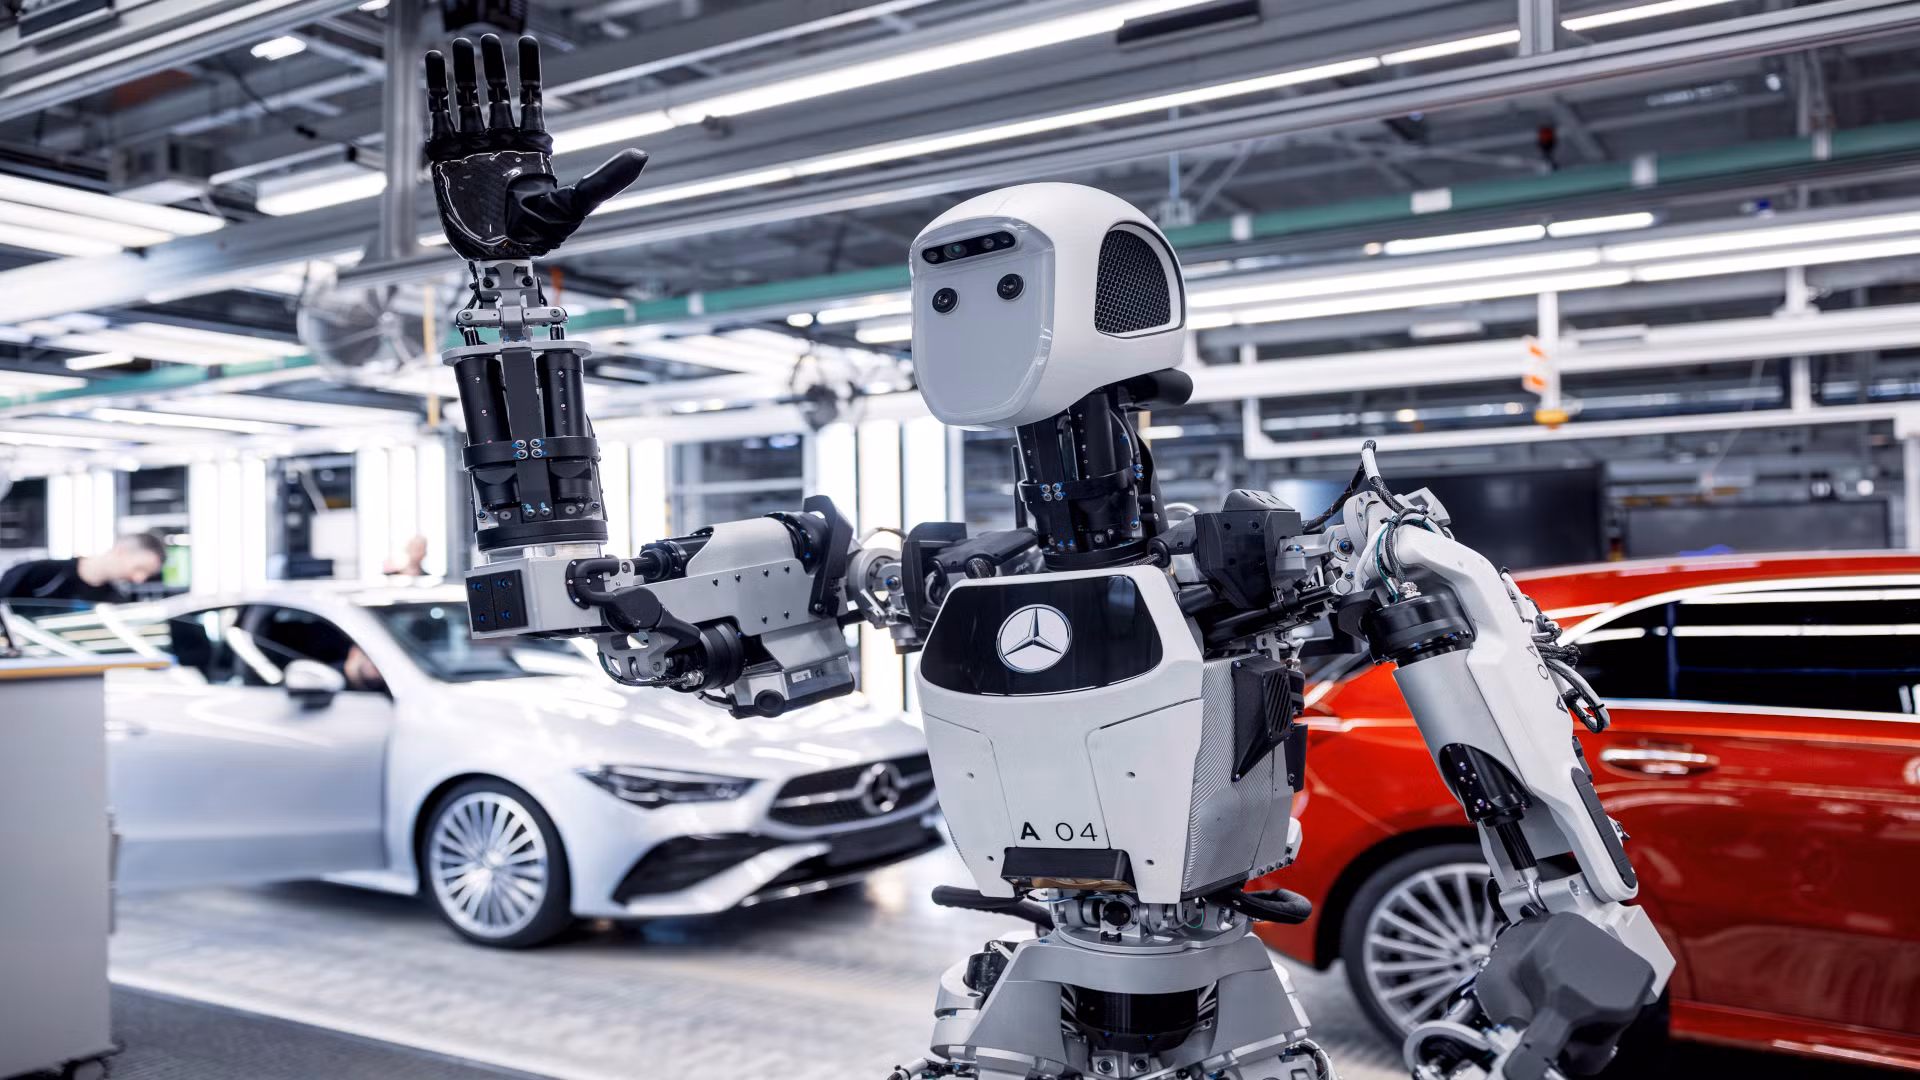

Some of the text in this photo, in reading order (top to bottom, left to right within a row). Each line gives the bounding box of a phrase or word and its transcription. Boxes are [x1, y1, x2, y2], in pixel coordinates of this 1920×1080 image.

[1525, 643, 1549, 680] 04
[1020, 821, 1098, 842] A 04
